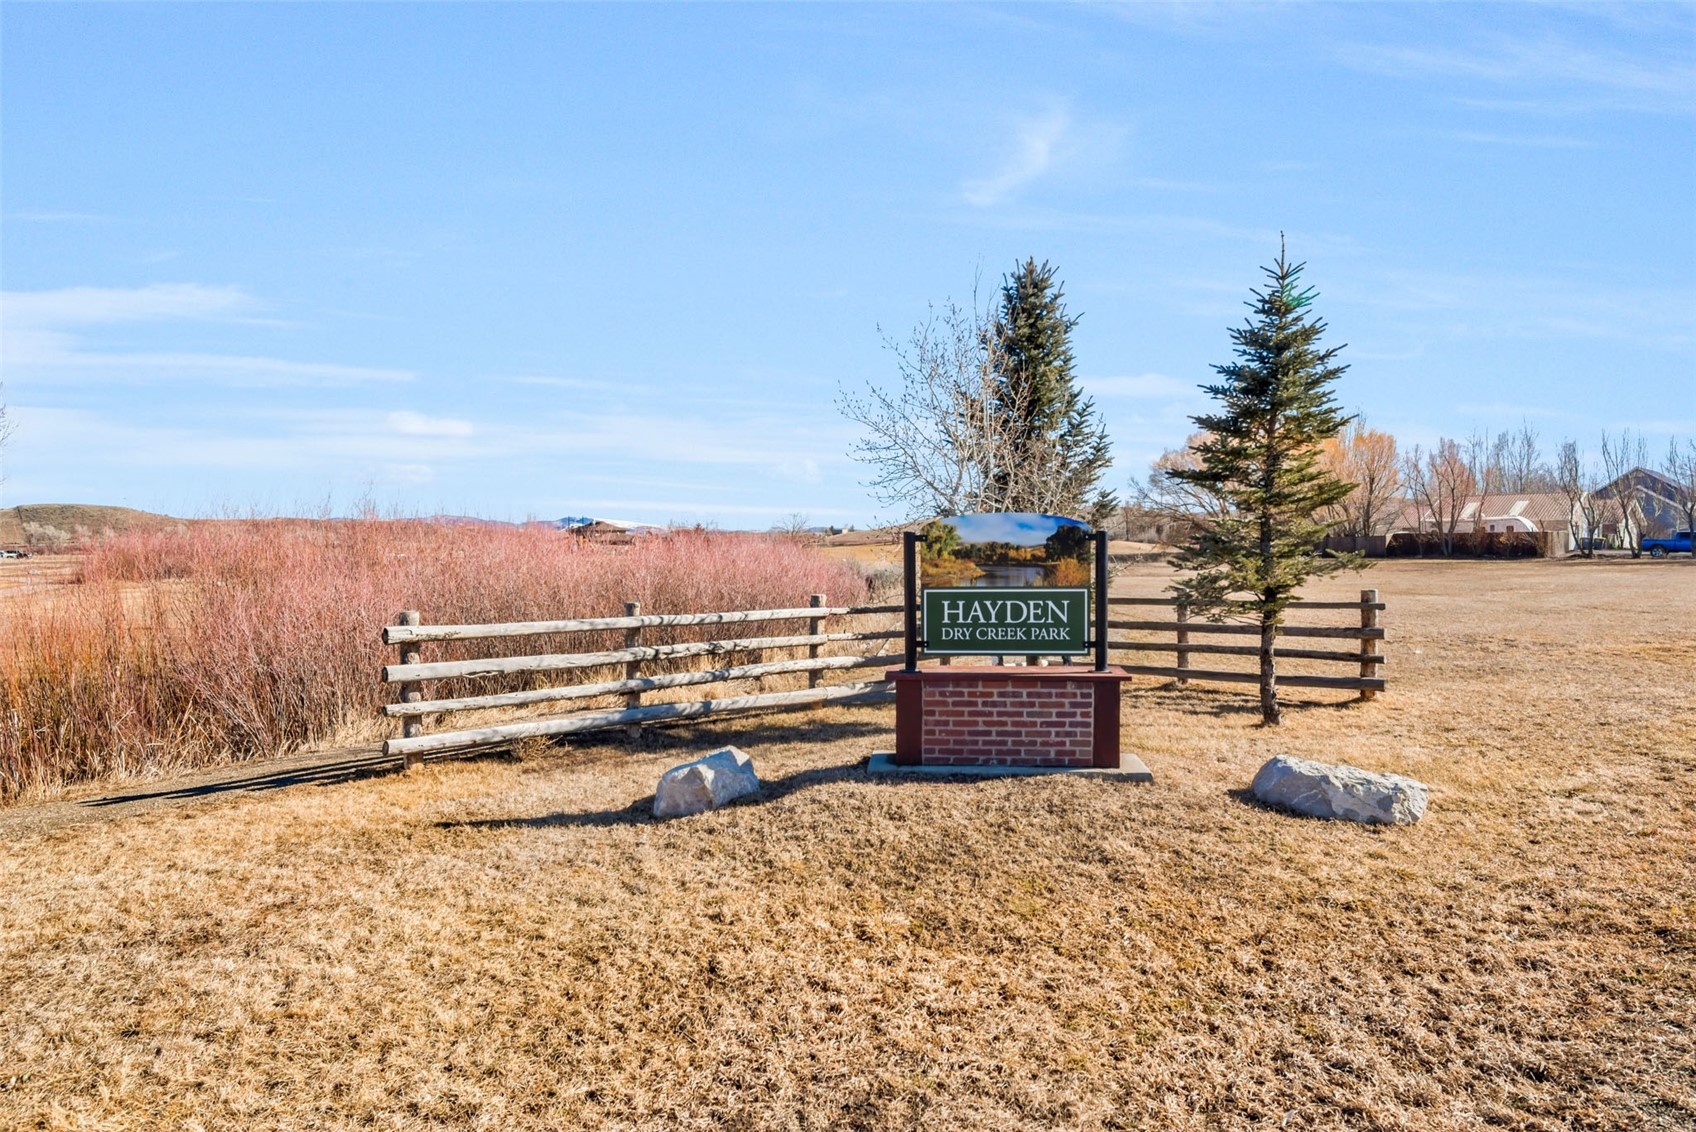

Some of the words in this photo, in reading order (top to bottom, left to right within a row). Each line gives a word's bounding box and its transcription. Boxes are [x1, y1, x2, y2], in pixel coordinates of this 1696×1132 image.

[941, 600, 1069, 624] HAYDEN
[941, 627, 972, 640] DRY
[975, 627, 1026, 640] CREEK
[1031, 627, 1070, 640] PARK
